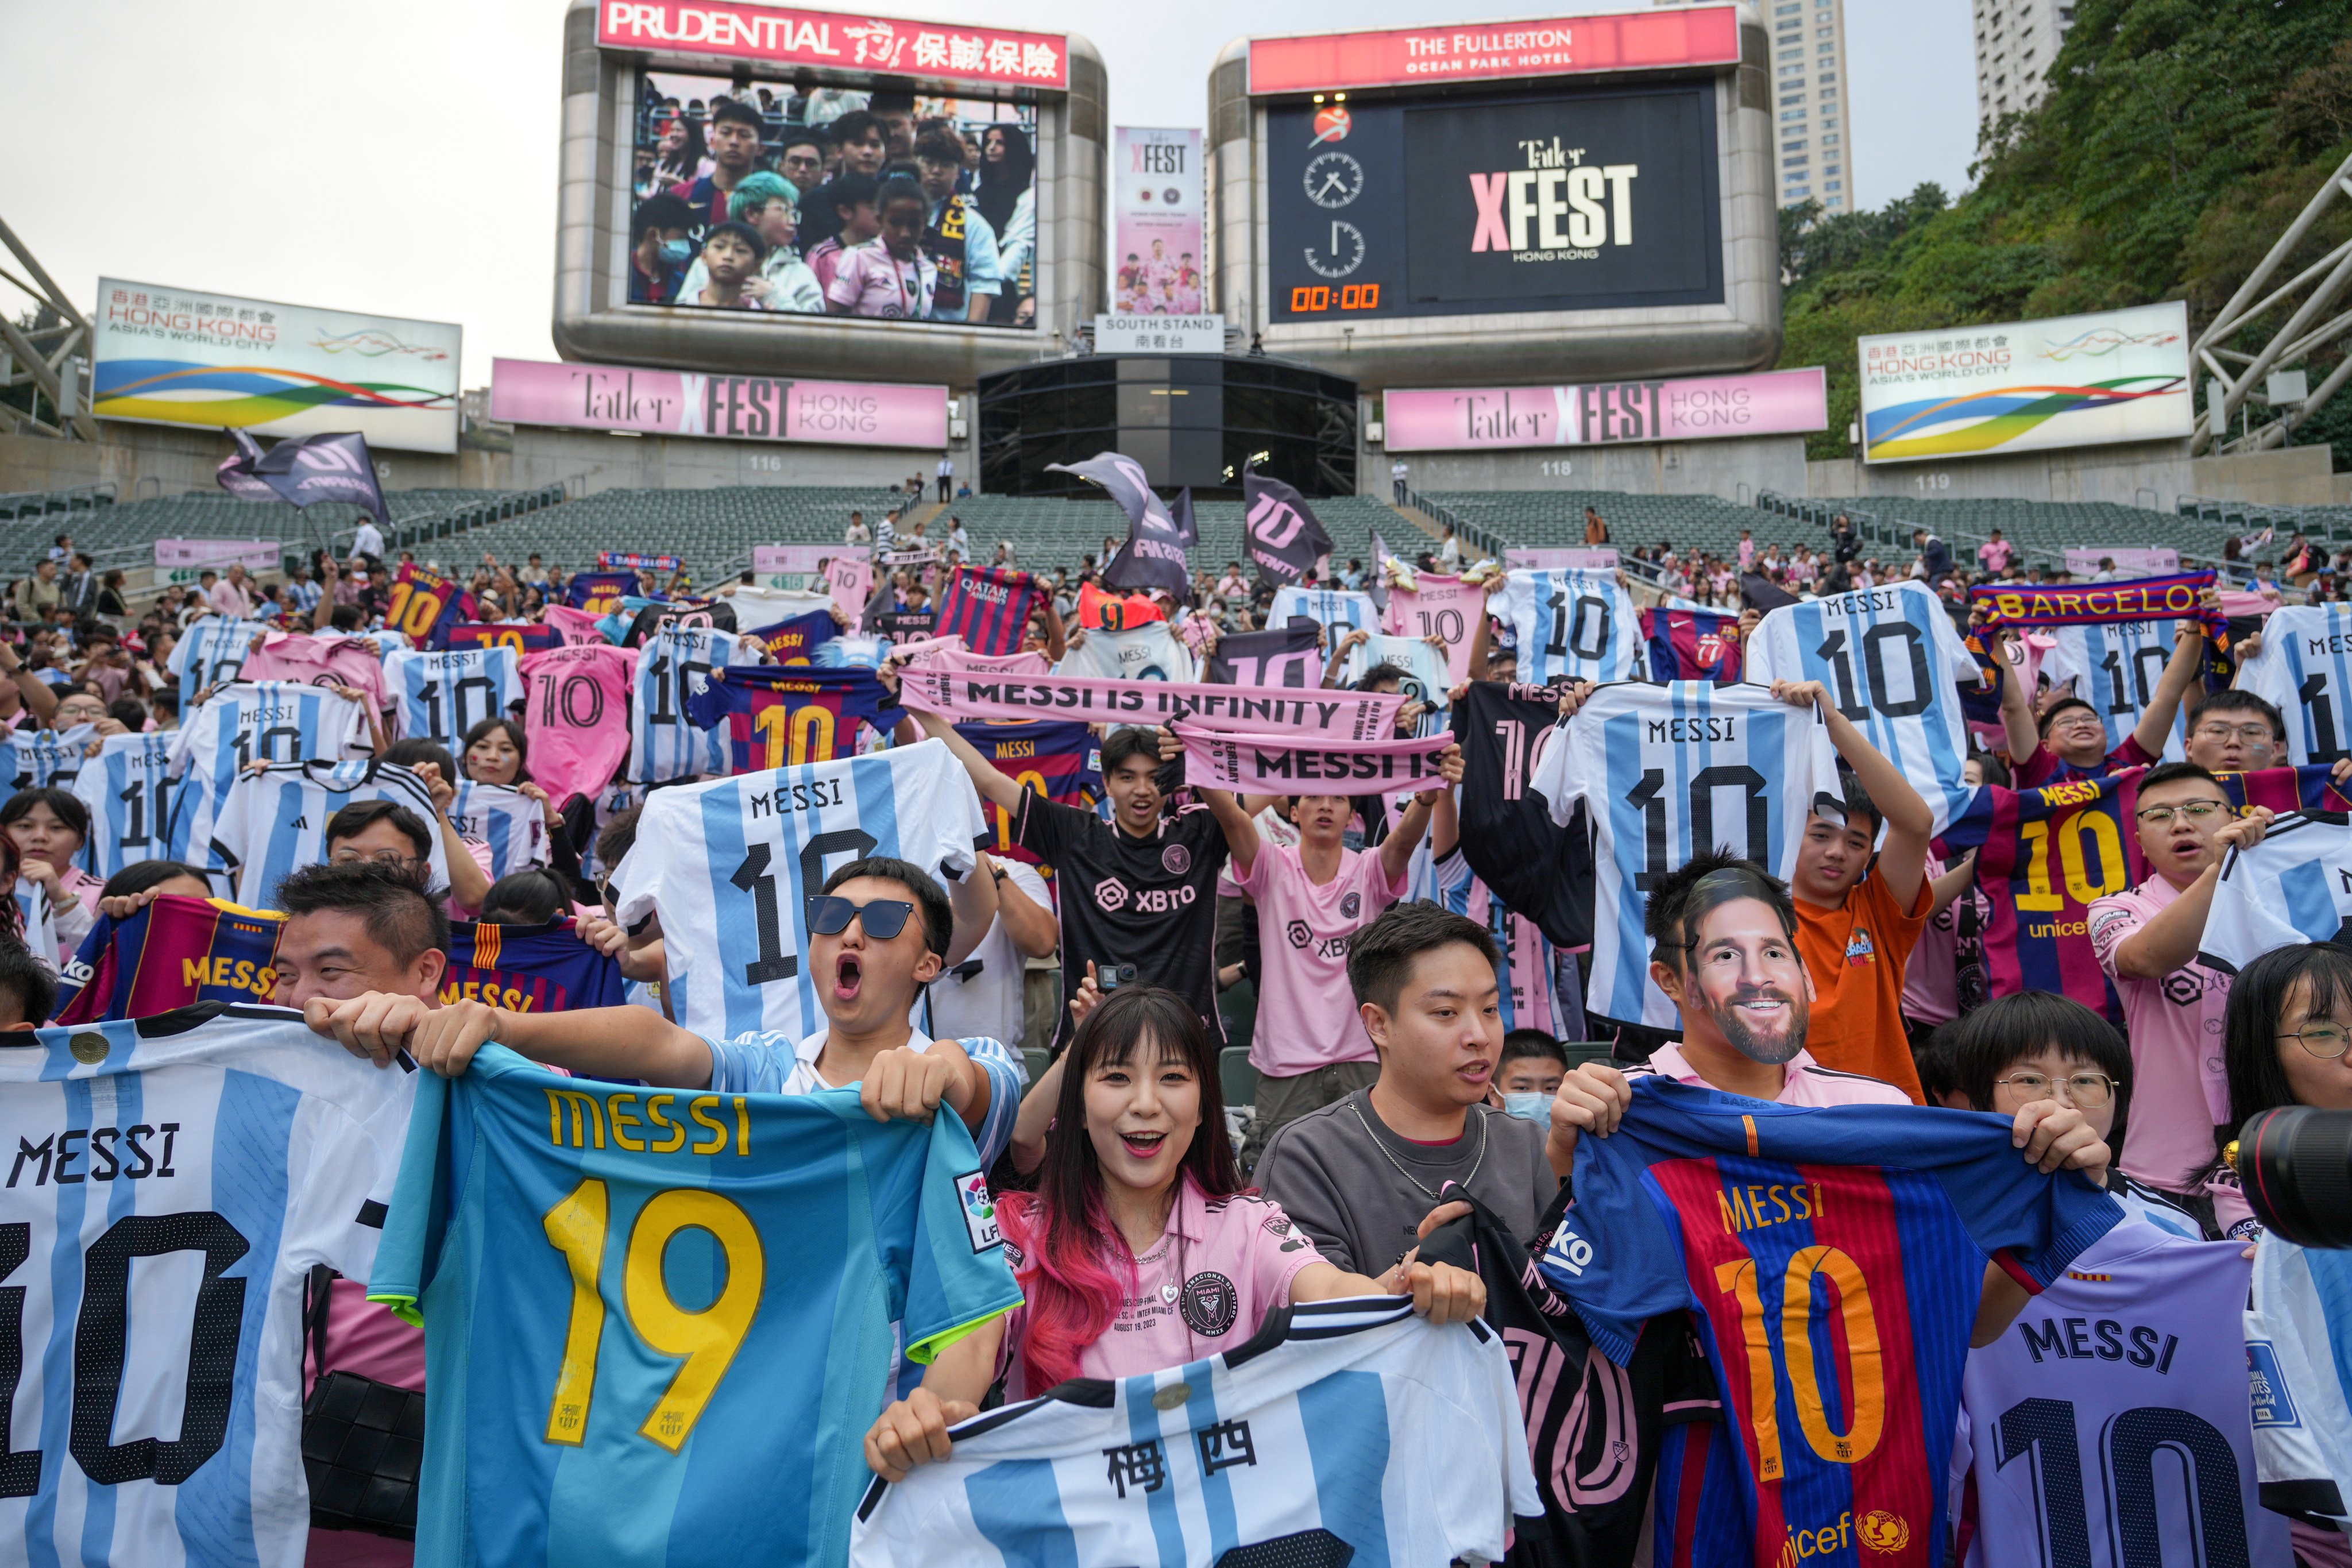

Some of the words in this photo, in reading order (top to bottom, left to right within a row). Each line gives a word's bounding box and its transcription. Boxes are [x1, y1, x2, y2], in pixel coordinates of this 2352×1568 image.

[608, 2, 840, 56] PRUDENTIAL
[912, 31, 1058, 78] 保誠保險
[1405, 37, 1447, 56] THE
[1453, 29, 1571, 53] FULLERTON
[1406, 60, 1462, 74] OCEAN
[1470, 56, 1511, 69] PARK
[1518, 52, 1573, 66] HOTEL
[1130, 144, 1186, 173] XFEST
[1518, 136, 1586, 168] Tatler
[1469, 164, 1638, 253] XFEST
[1513, 250, 1556, 262] HONG
[1557, 248, 1600, 260] KONG
[1291, 284, 1380, 312] 00:00
[109, 304, 191, 331] HONG
[197, 316, 277, 342] KONG
[1106, 319, 1157, 330] SOUTH
[1163, 319, 1214, 330] STAND
[109, 322, 165, 339] ASIA'S
[169, 331, 231, 347] WORLD
[234, 337, 275, 351] CITY
[1135, 335, 1184, 349] 南看台
[1867, 355, 1936, 376] HONG
[1940, 347, 2011, 369] KONG
[1868, 373, 1916, 386] ASIA'S
[1918, 369, 1972, 381] WORLD
[1975, 365, 2010, 376] CITY
[571, 371, 673, 424] Tatler
[679, 374, 795, 437] XFEST
[799, 393, 878, 414] HONG
[1670, 387, 1751, 408] HONG
[799, 414, 878, 432] KONG
[1454, 391, 1548, 441] Tatler
[1552, 382, 1664, 444] XFEST
[1670, 407, 1751, 428] KONG
[750, 455, 782, 472] 116
[1540, 461, 1573, 477] 118
[1914, 473, 1951, 491] 119
[1246, 492, 1306, 549] 10
[615, 555, 677, 569] BARCELONA
[836, 570, 858, 589] 10
[961, 577, 1009, 600] QATAR
[1552, 576, 1594, 591] MESSI
[970, 591, 1007, 605] AIRWAYS
[1420, 589, 1458, 601] MESSI
[1825, 591, 1894, 616] MESSI
[384, 582, 441, 638] 10
[896, 615, 930, 625] MESSI
[1416, 609, 1463, 645] 10
[1543, 591, 1609, 661] 10
[2107, 621, 2153, 639] MESSI
[205, 638, 241, 650] MESSI
[663, 632, 707, 650] MESSI
[430, 652, 477, 670] MESSI
[1118, 647, 1152, 665] MESSI
[1816, 621, 1933, 721] 10
[538, 674, 604, 728] 10
[1508, 680, 1578, 702] MESS
[240, 705, 293, 724] MESSI
[967, 681, 1091, 708] MESSI
[1108, 689, 1144, 711] IS
[1157, 692, 1341, 729] INFINITY
[1357, 700, 1369, 717] KONG
[1353, 719, 1365, 741] HONG
[1366, 700, 1382, 741] STADIUM
[1648, 716, 1735, 743] MESSI
[755, 704, 835, 770] 10
[995, 740, 1035, 759] MESSI
[21, 746, 76, 762] MESSI
[1255, 748, 1393, 779] MESSI
[750, 777, 843, 819] MESSI
[2037, 779, 2101, 807] MESSI
[1625, 765, 1767, 891] 10
[2015, 810, 2126, 912] 10
[1136, 885, 1196, 913] XBTO
[1845, 941, 1874, 957] DRAGON
[182, 956, 277, 1001] MESS
[438, 981, 535, 1013] MESSI
[542, 1087, 750, 1157] MESSI
[6, 1122, 180, 1188] MESSI
[1716, 1182, 1825, 1235] MESSI
[1267, 1219, 1288, 1228] MLS
[1196, 1287, 1220, 1296] MIAMI
[1226, 1281, 1233, 1291] DE
[1122, 1311, 1129, 1319] SC
[1137, 1308, 1150, 1318] INTER
[1152, 1307, 1167, 1317] MIAMI
[1168, 1306, 1174, 1315] CF
[1134, 1297, 1143, 1306] CUP
[1144, 1295, 1157, 1306] FINAL
[541, 1175, 767, 1457] 19
[1114, 1322, 1133, 1332] AUGUST
[1134, 1321, 1142, 1331] 19,
[1144, 1319, 1156, 1330] 2023
[2019, 1317, 2179, 1375] MESSI
[1713, 1245, 1886, 1483] 10
[1991, 1397, 2250, 1568] 10
[1777, 1512, 1852, 1568] unicef
